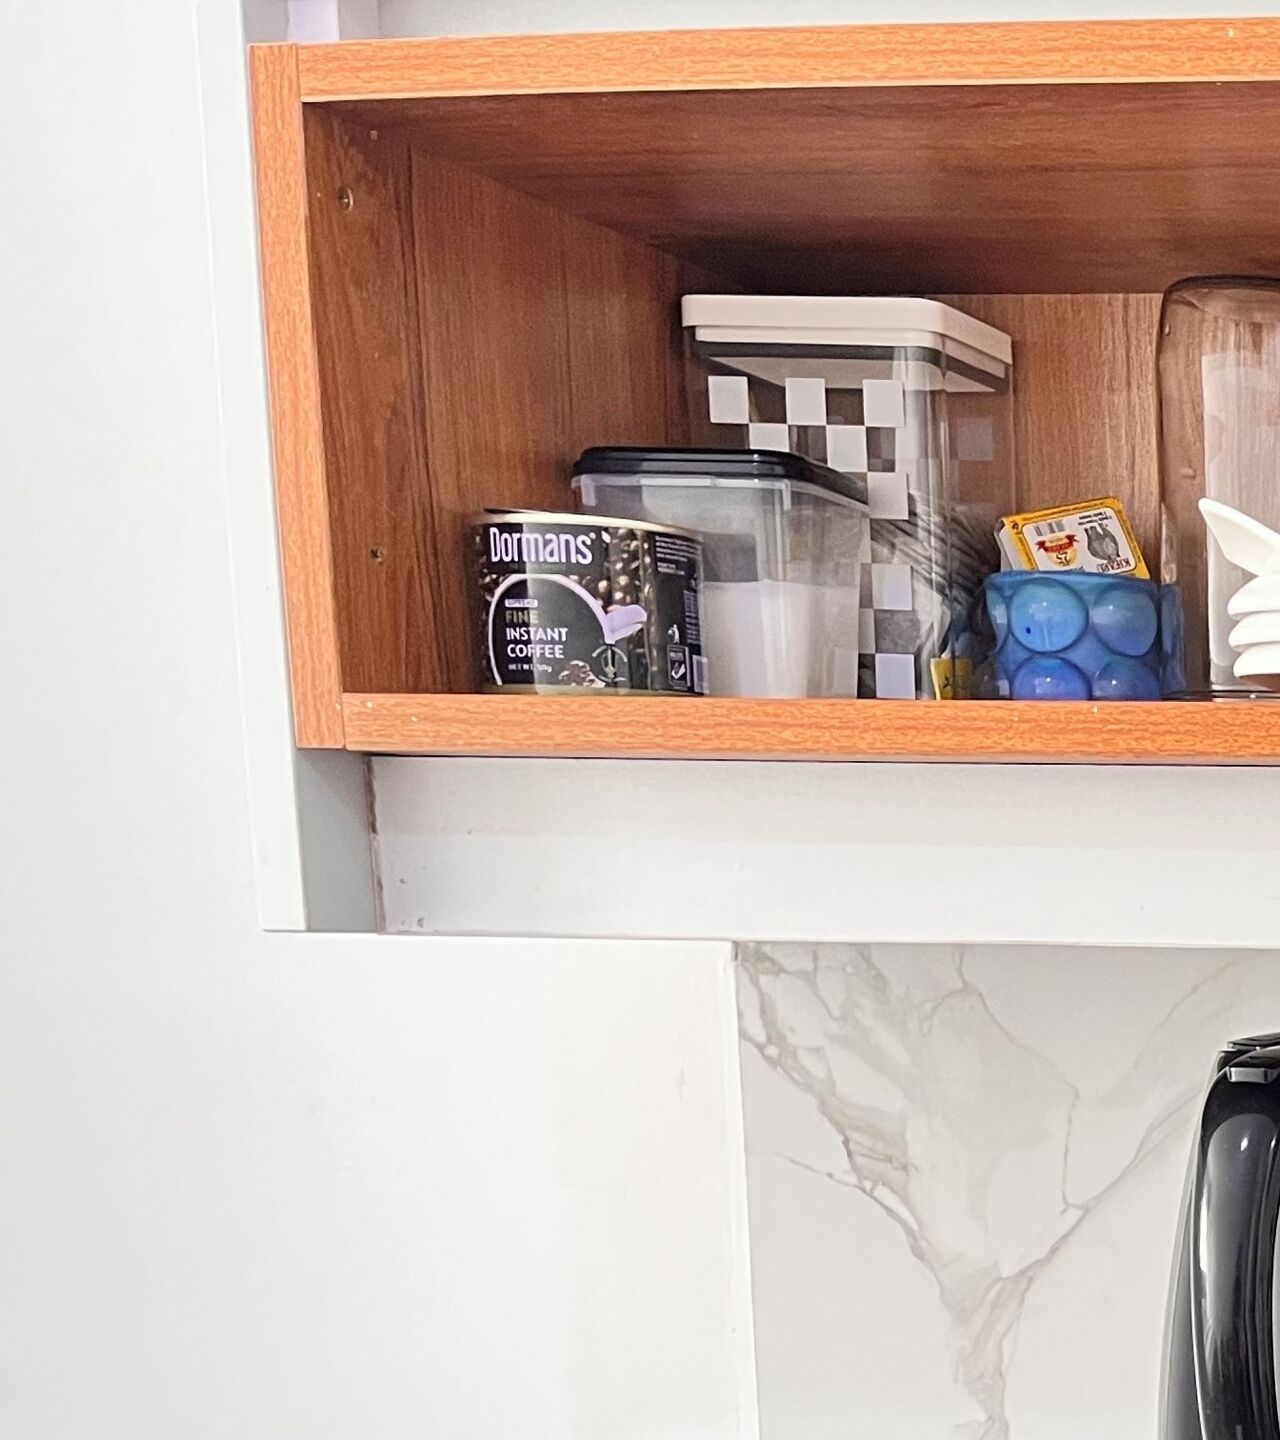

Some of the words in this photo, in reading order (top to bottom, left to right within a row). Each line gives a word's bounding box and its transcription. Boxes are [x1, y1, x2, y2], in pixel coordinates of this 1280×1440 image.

[489, 527, 593, 564] Dormans
[505, 610, 539, 624] FINE
[505, 627, 568, 641] INSTANT
[507, 643, 565, 658] COFFEE
